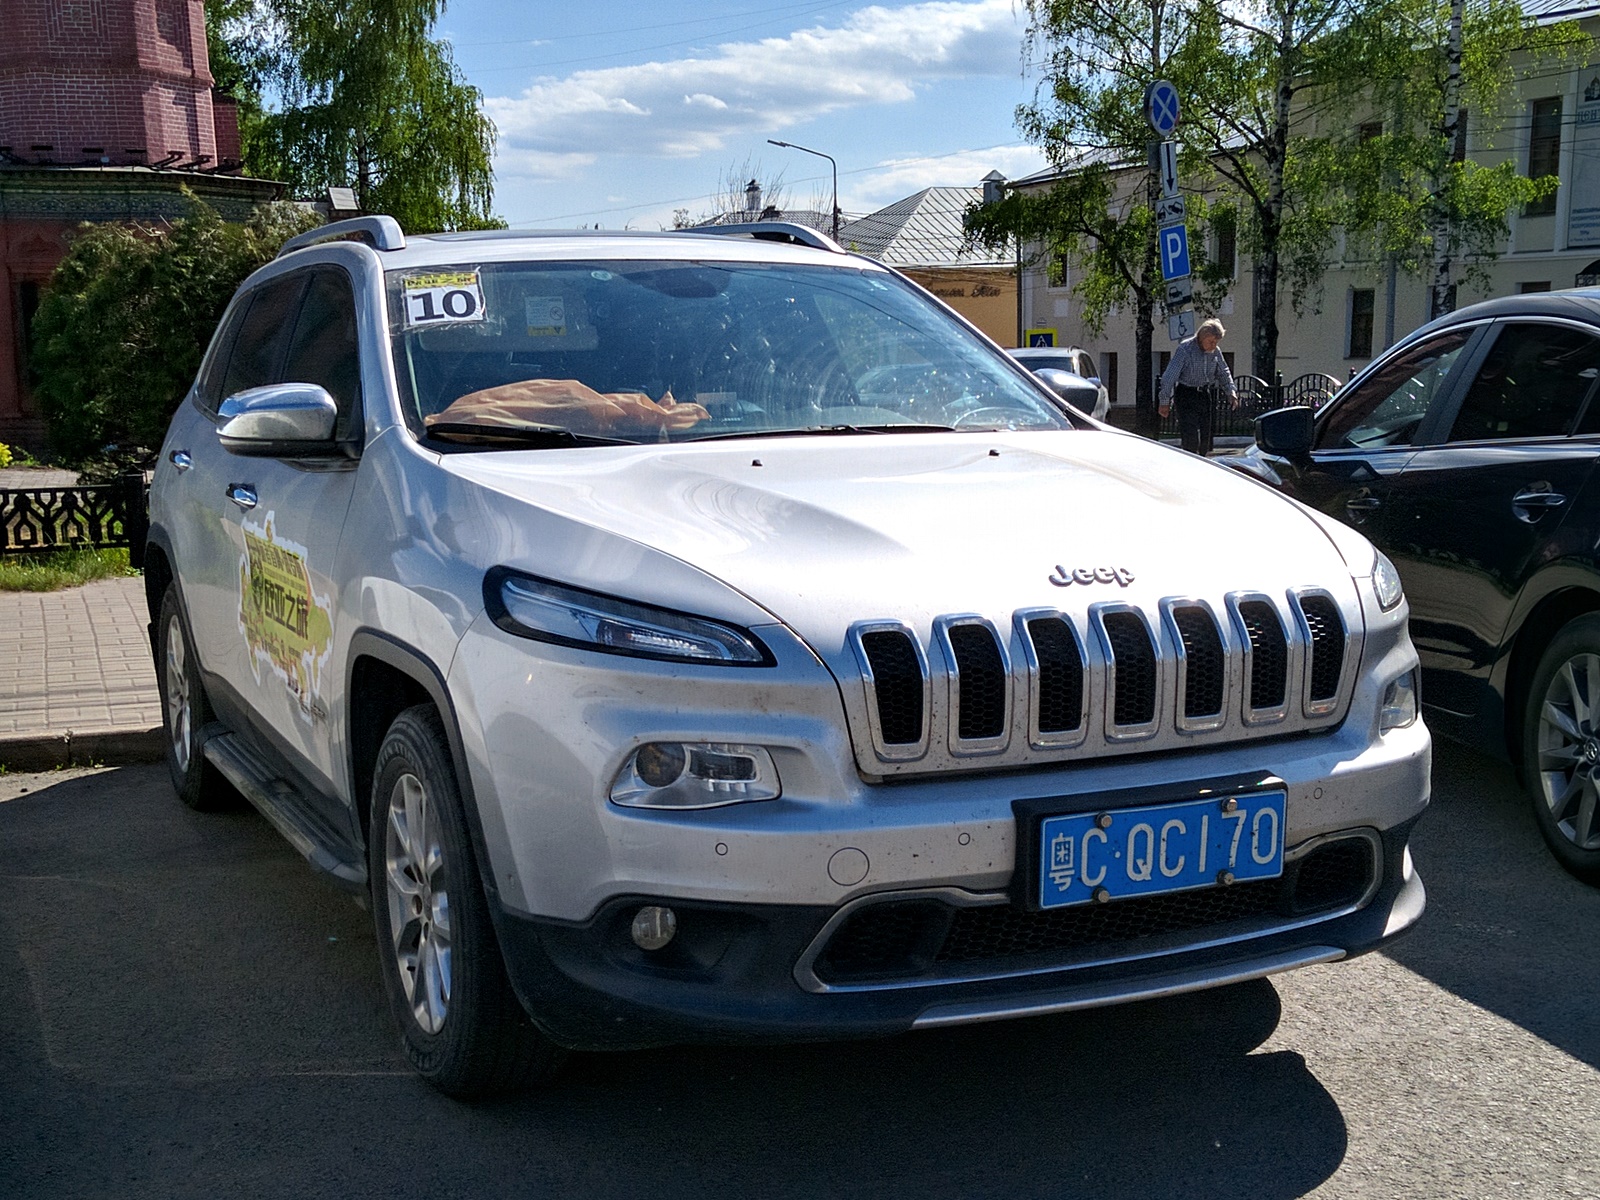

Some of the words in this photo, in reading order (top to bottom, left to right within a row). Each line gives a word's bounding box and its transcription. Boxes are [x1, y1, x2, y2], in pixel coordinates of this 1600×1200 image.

[1166, 232, 1182, 273] P
[411, 289, 477, 321] 10
[1048, 564, 1135, 588] Jeep
